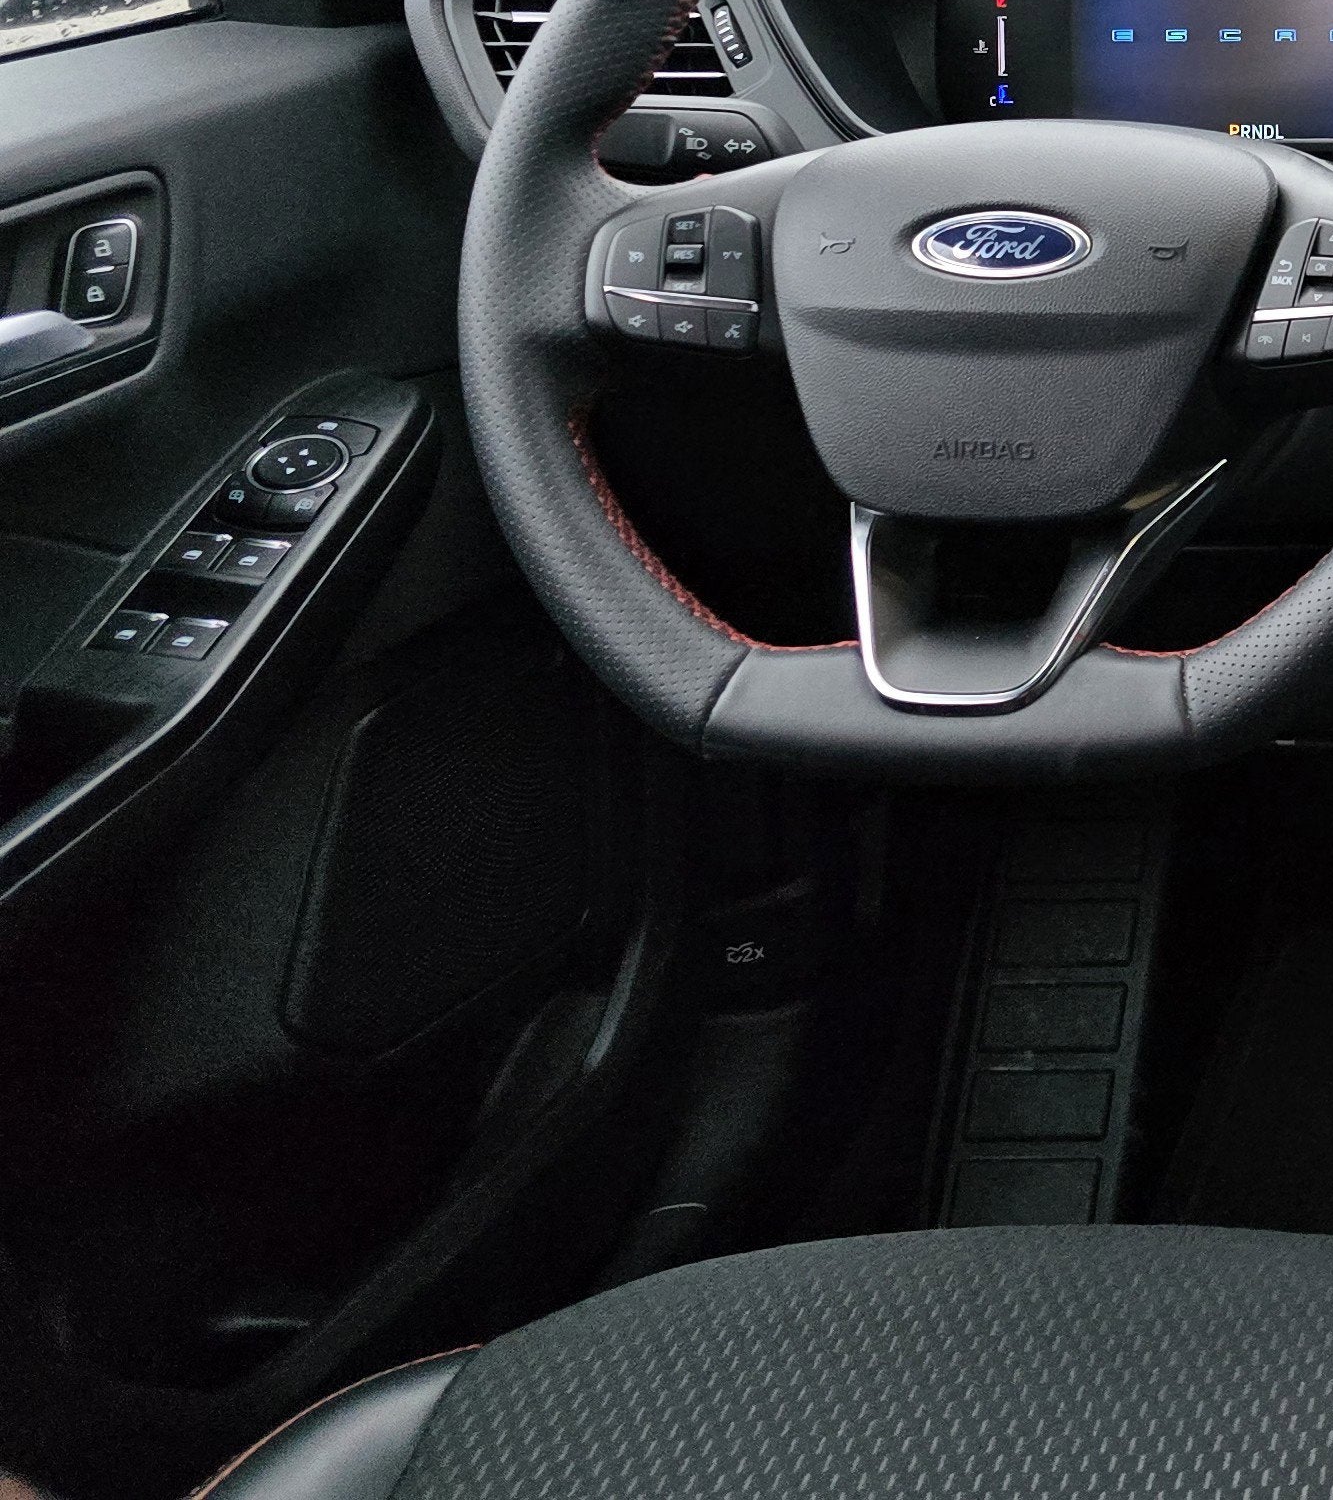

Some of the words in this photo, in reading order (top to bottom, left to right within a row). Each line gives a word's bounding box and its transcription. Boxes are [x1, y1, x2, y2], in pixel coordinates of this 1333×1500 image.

[951, 225, 1044, 260] Ford
[674, 250, 694, 260] RES
[1271, 275, 1293, 286] BACK
[932, 438, 1036, 462] AIRBAG
